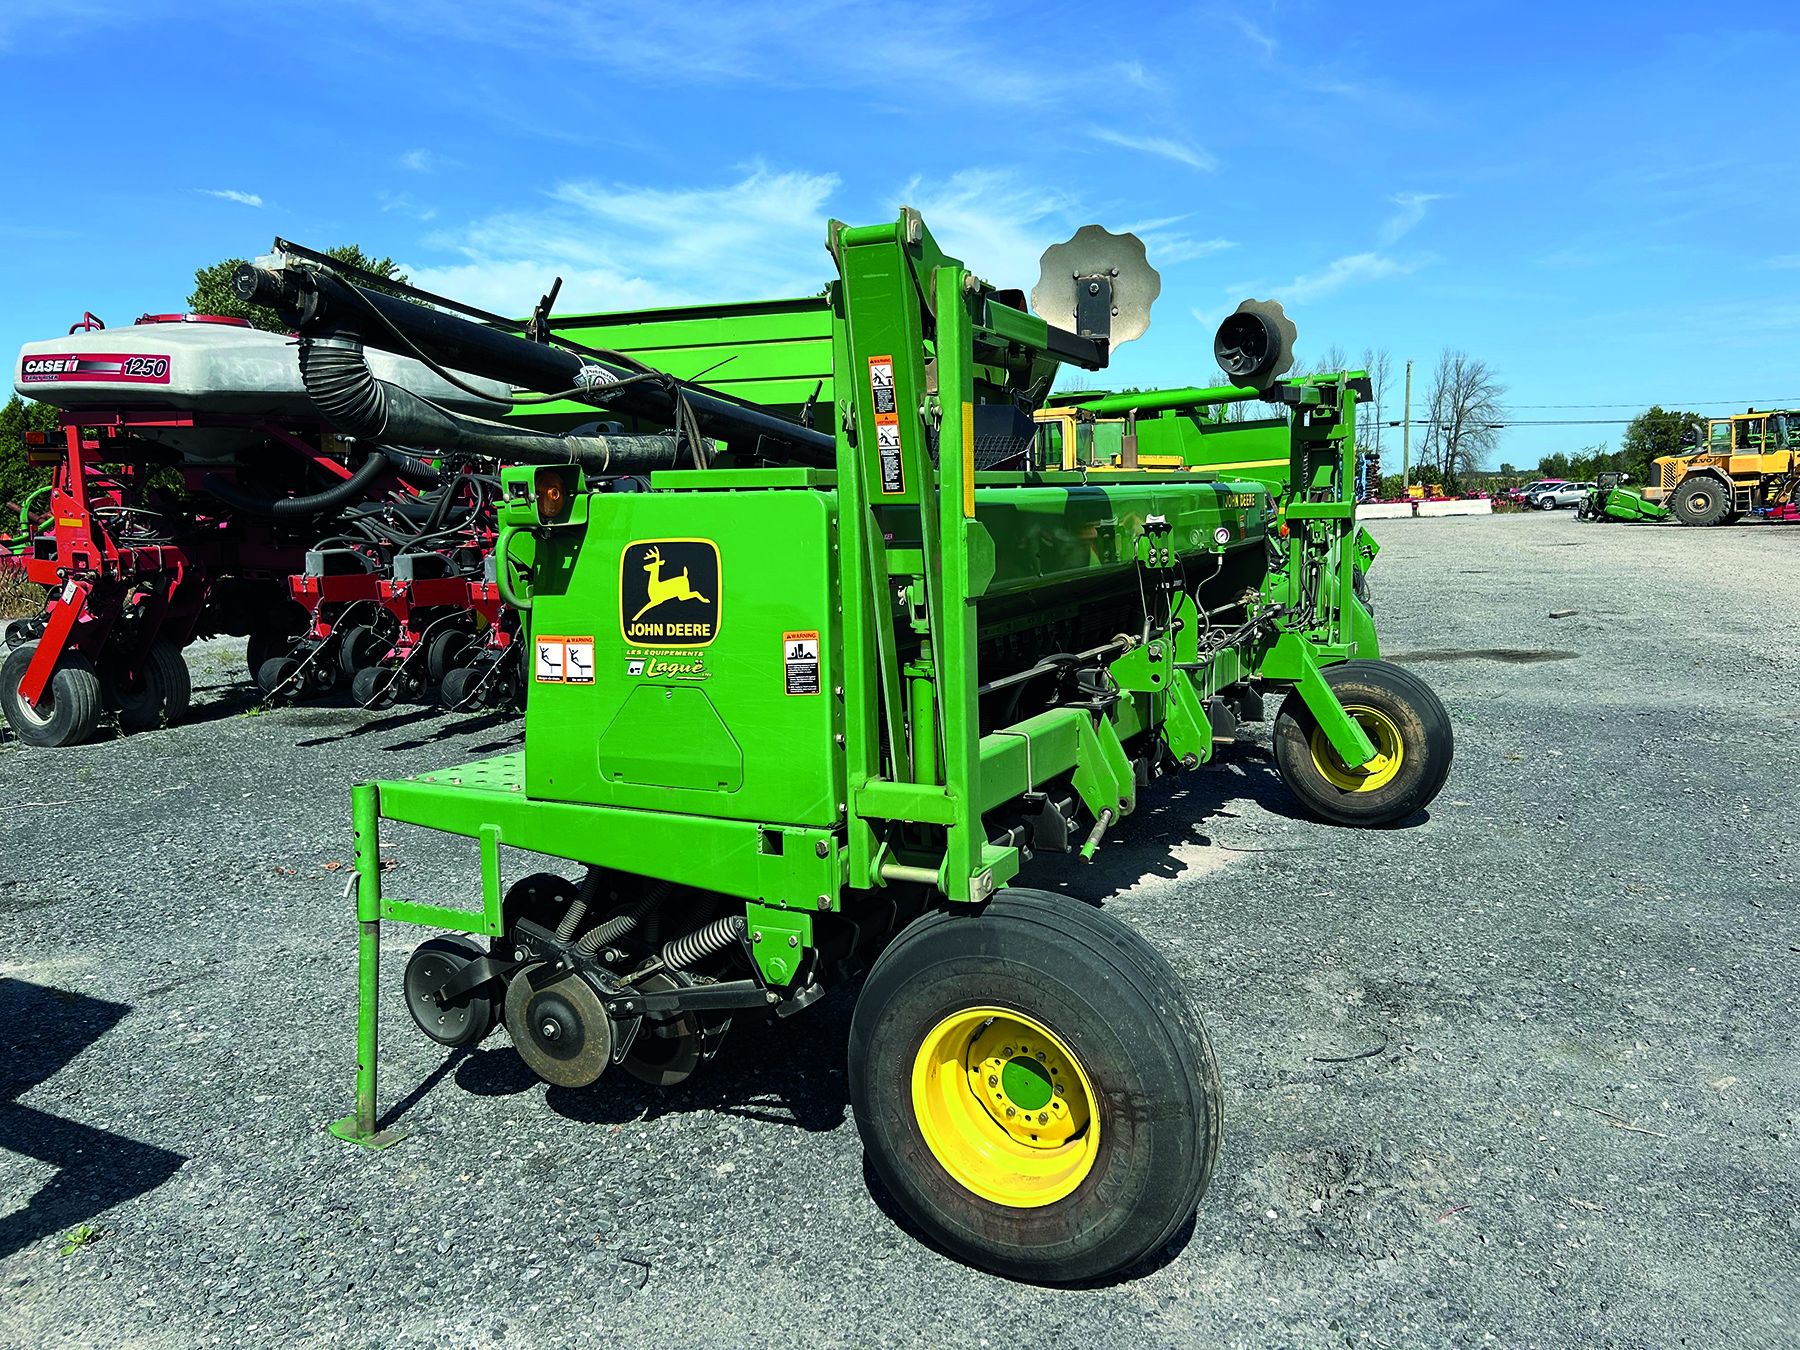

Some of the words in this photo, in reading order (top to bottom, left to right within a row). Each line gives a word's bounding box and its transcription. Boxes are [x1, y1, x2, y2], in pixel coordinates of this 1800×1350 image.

[25, 360, 64, 373] CASE
[124, 357, 168, 378] 1250
[1240, 493, 1255, 507] DEERE
[627, 623, 663, 636] JOHN
[666, 623, 711, 636] DEERE
[644, 648, 704, 657] ÉQUIPEMENTS
[646, 657, 707, 678] Laguë
